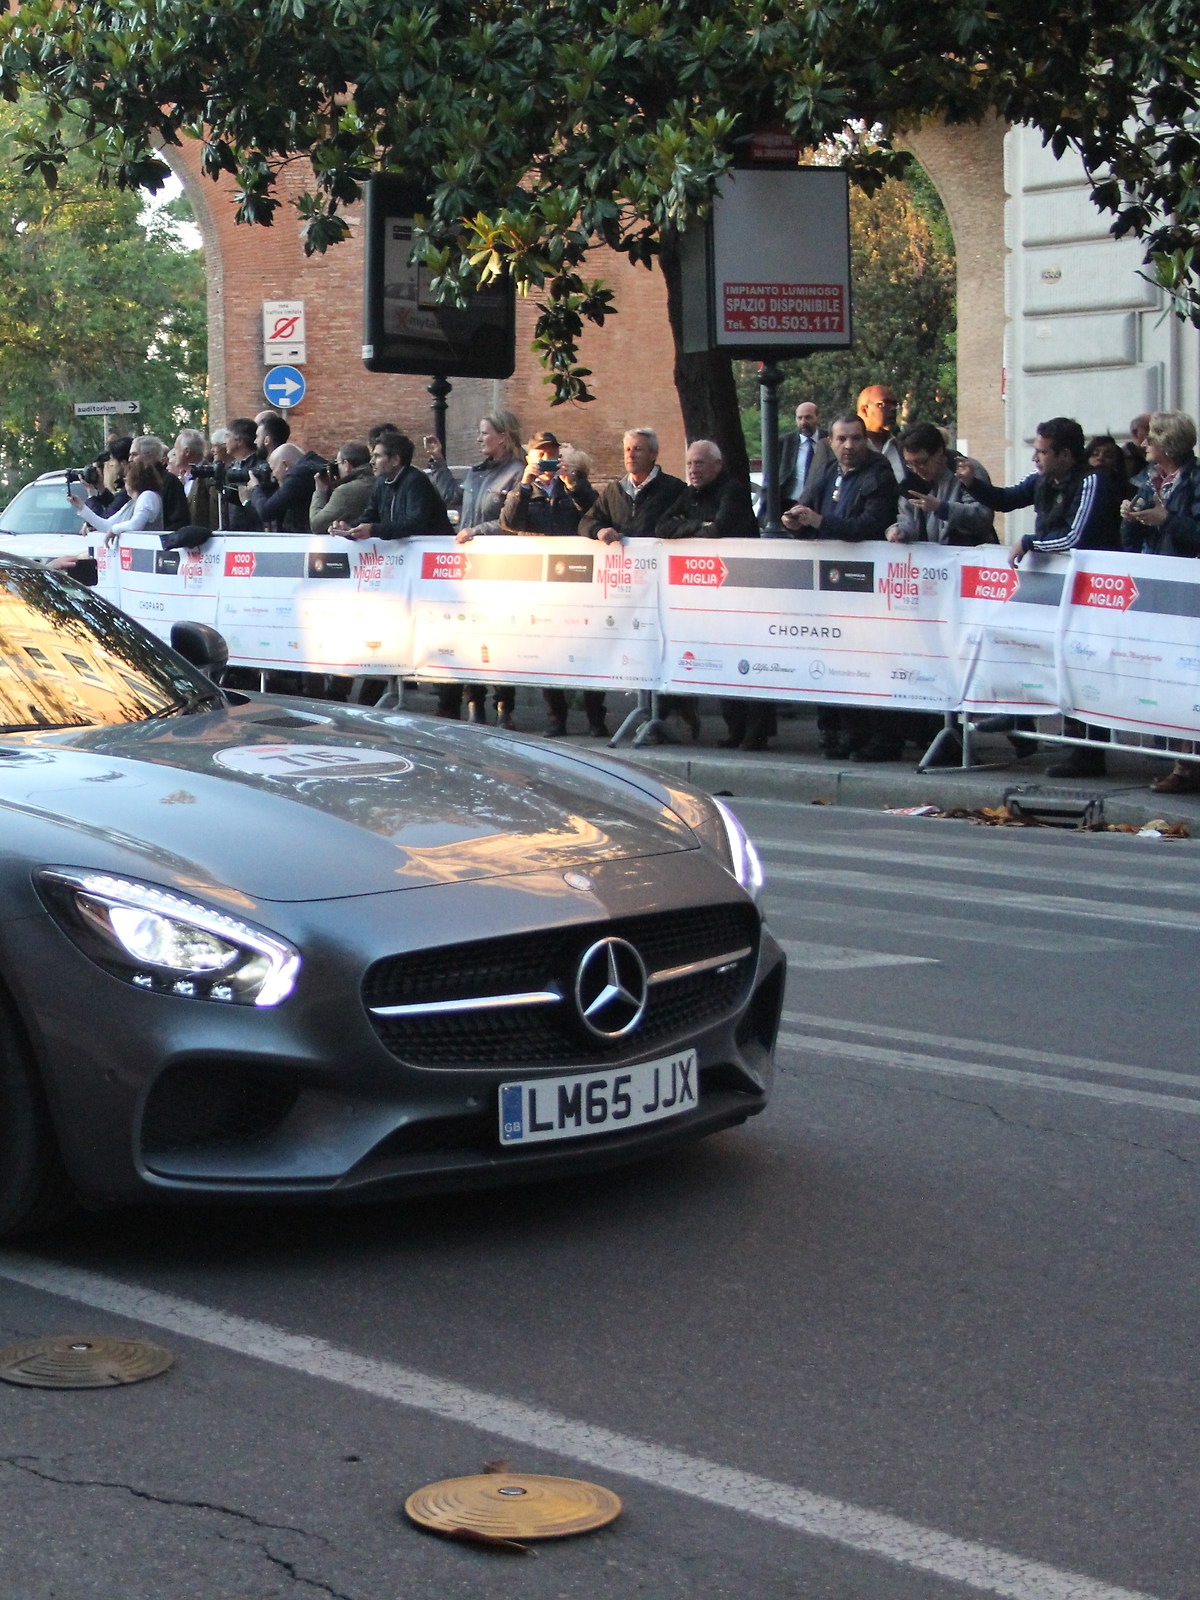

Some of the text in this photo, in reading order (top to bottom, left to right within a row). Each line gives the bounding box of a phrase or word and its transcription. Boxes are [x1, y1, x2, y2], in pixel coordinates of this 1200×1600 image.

[726, 286, 839, 296] IMPIANTO LUMINOSO
[726, 298, 840, 313] SPAZIO DISPONIBILE
[726, 316, 840, 330] Tel. 360.503.117
[77, 405, 116, 413] auditorium
[205, 554, 221, 565] 2016
[234, 554, 250, 563] 1000
[359, 544, 385, 566] Mille
[385, 554, 405, 566] 2016
[435, 555, 461, 565] 1000
[605, 545, 658, 570] Mille 2016
[231, 566, 251, 576] MIGLIA
[685, 559, 715, 570] 1000
[887, 552, 948, 581] Mille 2016
[353, 565, 382, 592] Miglia
[432, 568, 462, 578] MIGLIA
[682, 573, 718, 584] MIGLIA
[597, 569, 632, 599] Miglia
[1090, 576, 1125, 590] 1000
[878, 578, 919, 610] Miglia
[1087, 593, 1125, 607] MIGLIA
[139, 600, 165, 612] CHOPARD
[768, 624, 842, 639] CHOPARD
[258, 751, 361, 767] 715
[528, 1057, 696, 1133] LM65 JJX
[504, 1121, 521, 1133] GB
